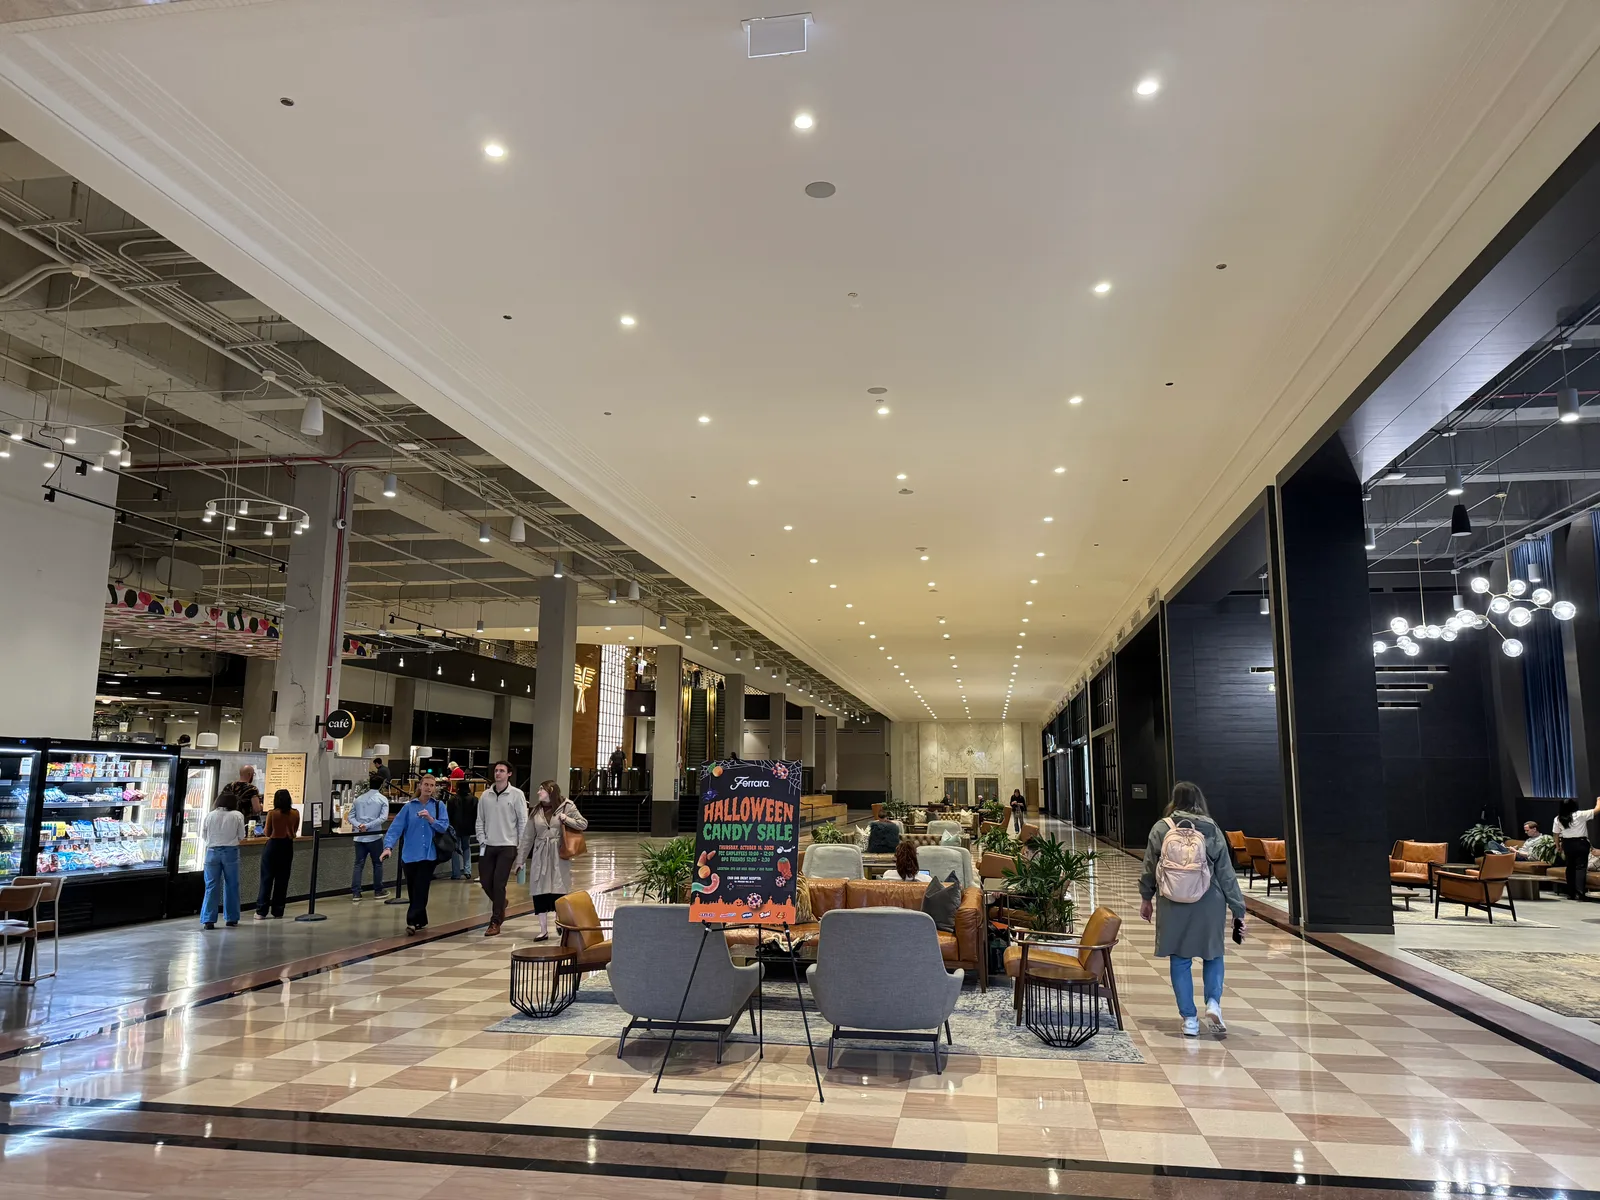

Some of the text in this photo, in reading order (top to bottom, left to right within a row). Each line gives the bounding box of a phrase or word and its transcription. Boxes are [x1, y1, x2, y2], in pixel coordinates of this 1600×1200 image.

[328, 718, 349, 728] café
[730, 776, 770, 790] Ferrara
[704, 797, 794, 822] HALLOWEEN
[703, 824, 793, 842] CANDY SALE
